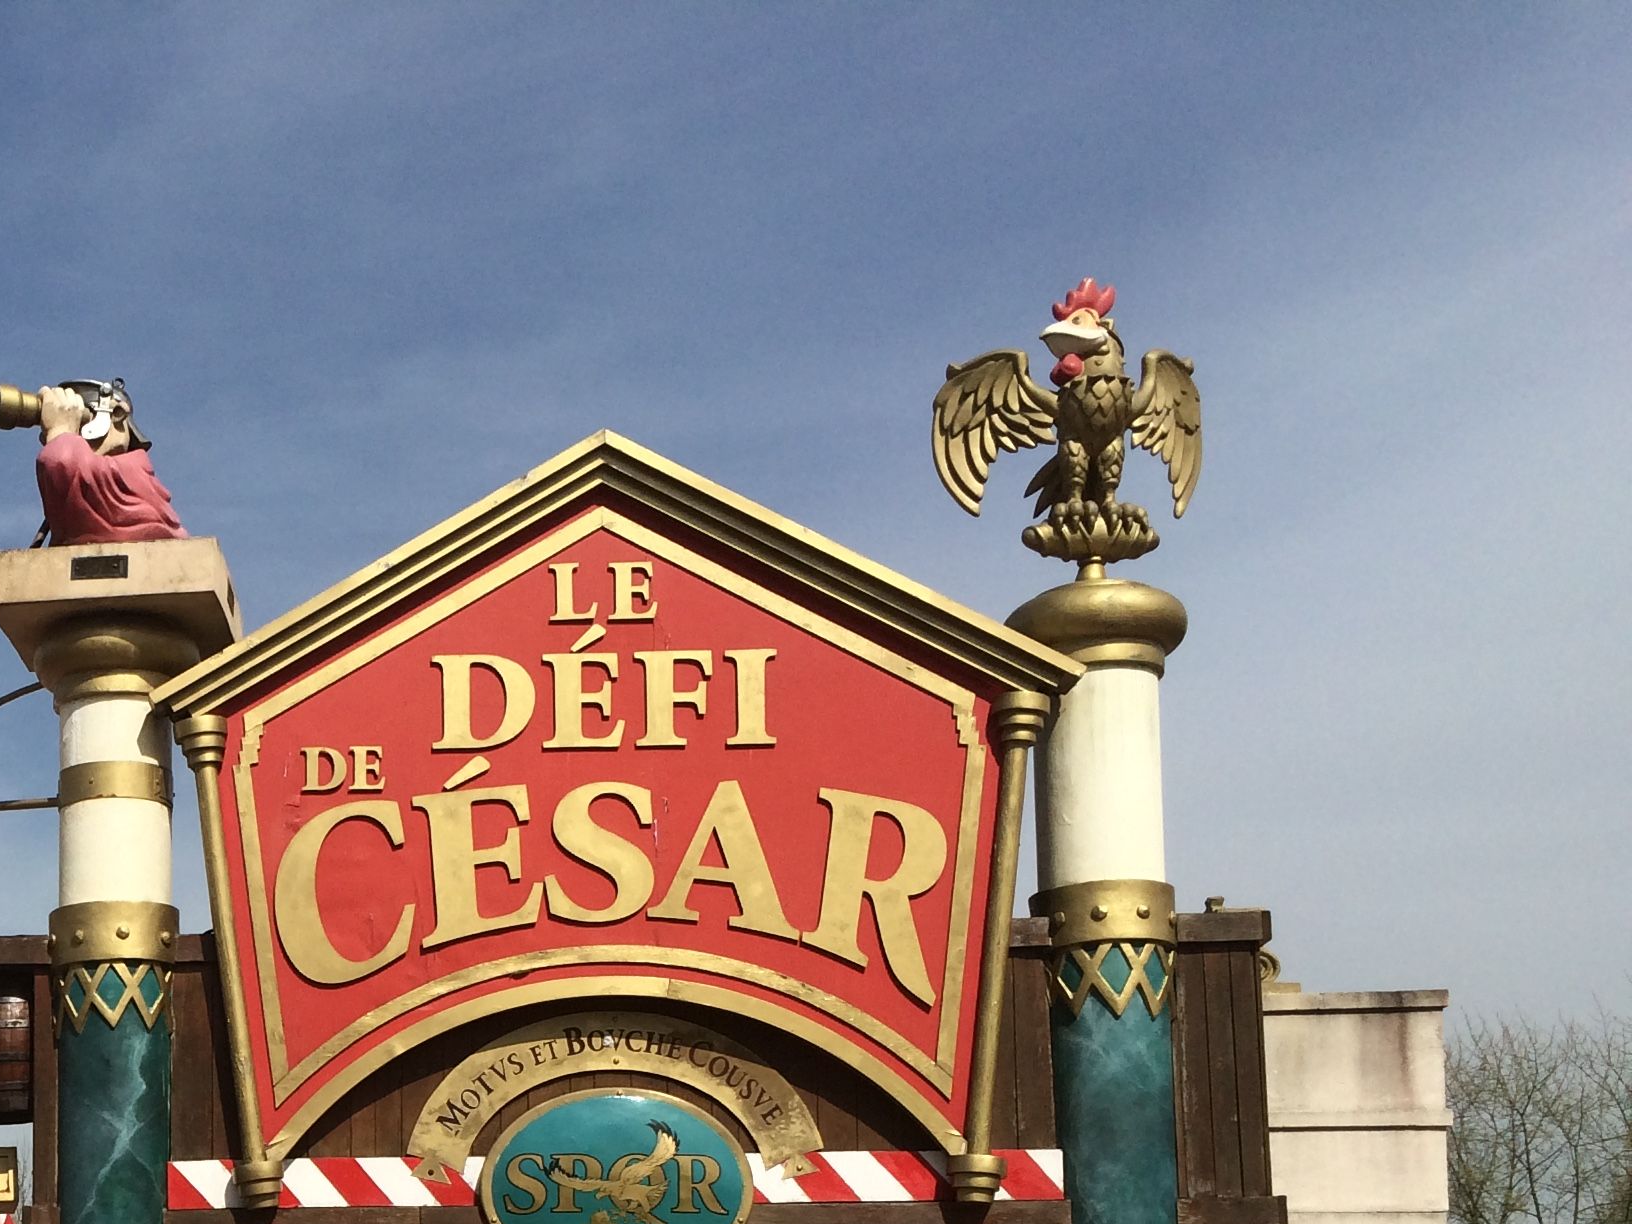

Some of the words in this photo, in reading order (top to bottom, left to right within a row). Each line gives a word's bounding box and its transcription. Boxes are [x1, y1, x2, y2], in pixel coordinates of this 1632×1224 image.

[549, 560, 659, 623] LE
[431, 623, 778, 750] DÉFI
[300, 745, 386, 793] DE
[273, 755, 948, 1013] CÉSAR
[435, 1053, 525, 1136] MOTVS
[530, 1039, 559, 1067] ET
[562, 1026, 683, 1060] BOVCHE
